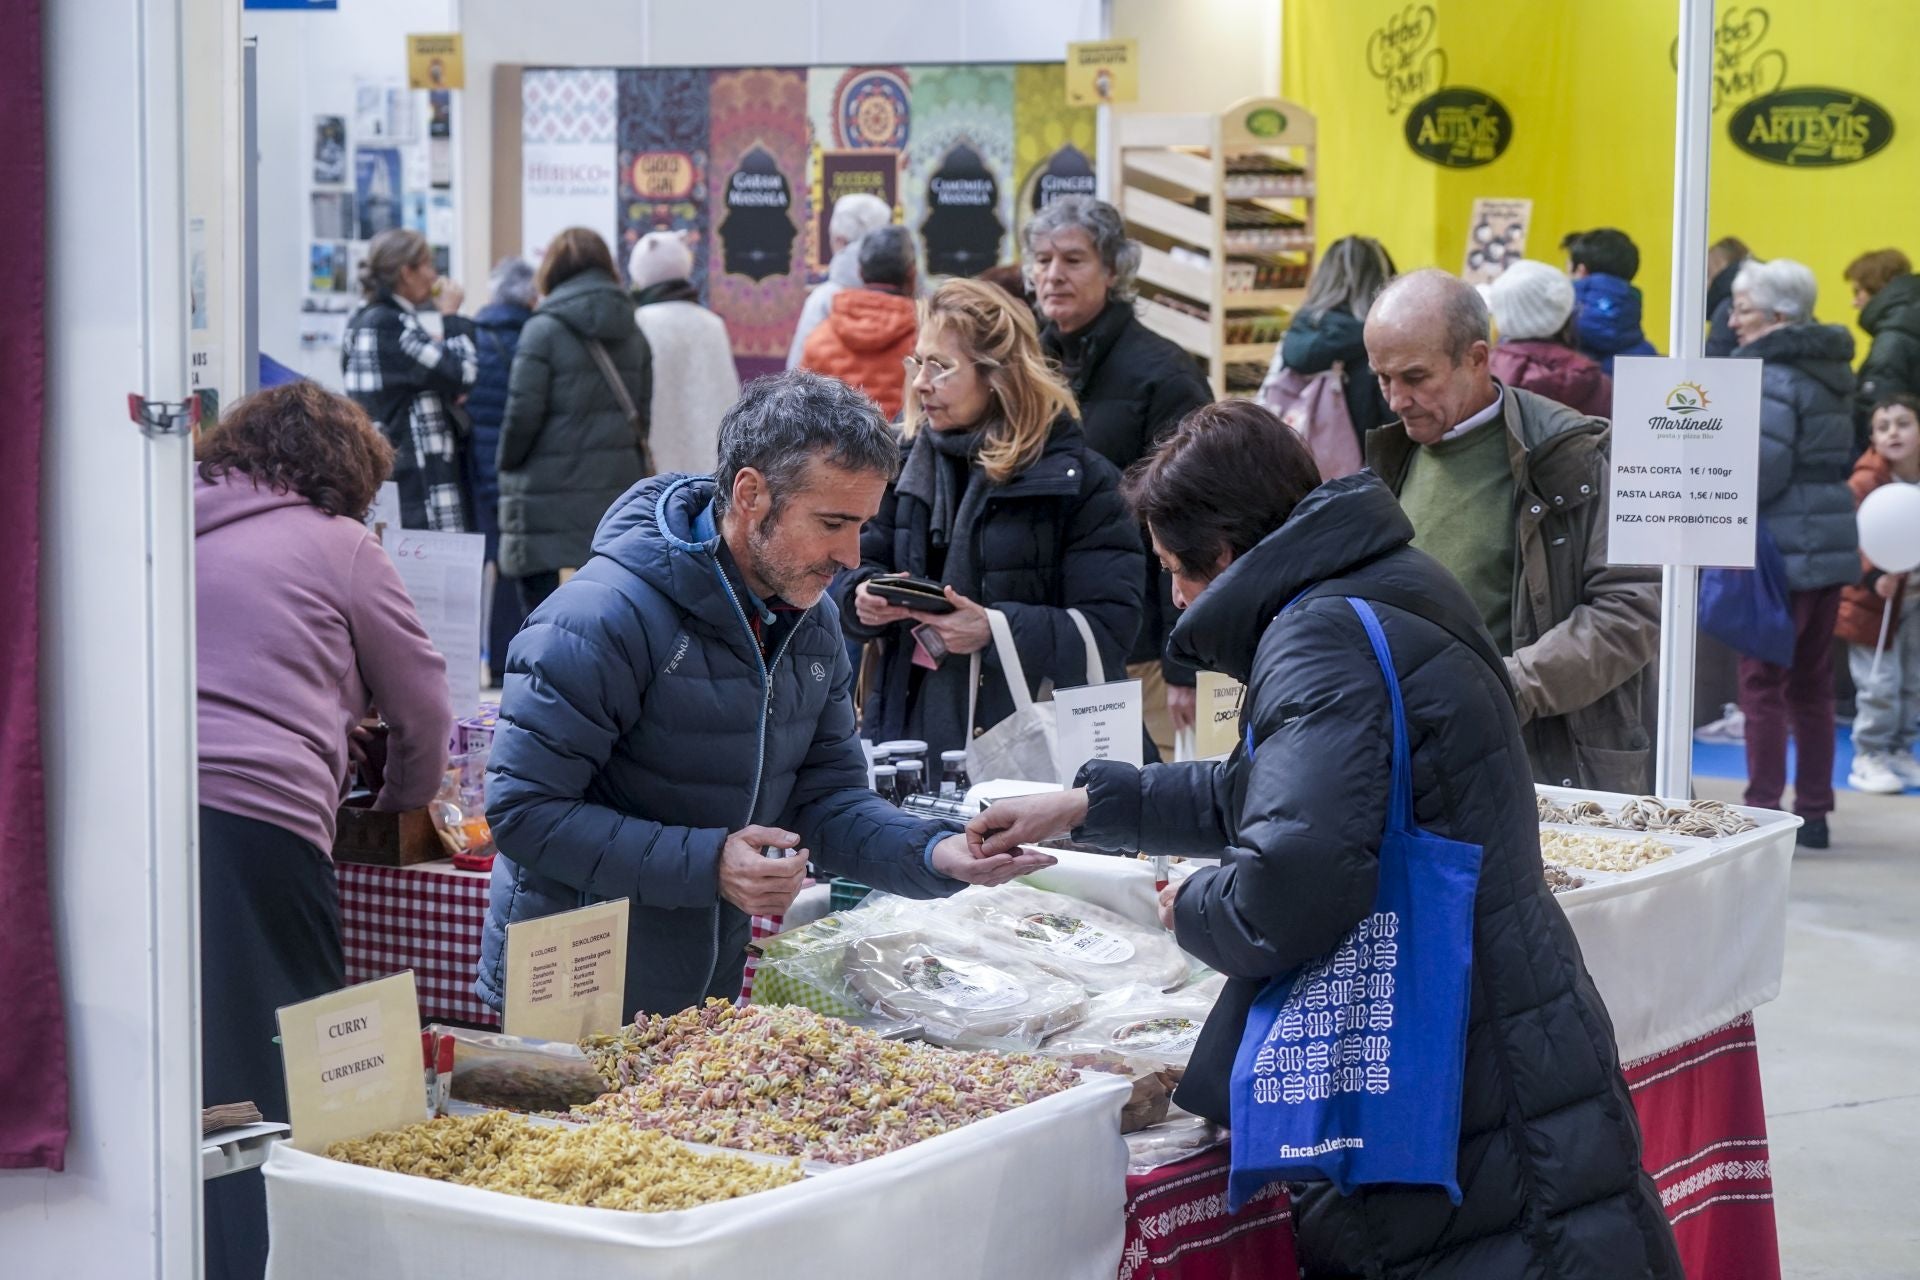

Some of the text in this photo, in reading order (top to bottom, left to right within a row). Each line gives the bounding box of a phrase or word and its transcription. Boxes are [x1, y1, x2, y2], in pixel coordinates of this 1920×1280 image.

[1748, 114, 1871, 144] ARTEMIS
[1648, 416, 1723, 431] Martinelli
[1657, 432, 1676, 440] pasta
[1682, 433, 1701, 441] pizza
[1617, 466, 1647, 474] PASTA
[1650, 466, 1682, 475] CORTA
[1690, 467, 1700, 475] 1€
[1708, 467, 1732, 477] 100gr
[1617, 490, 1647, 499] PASTA
[1649, 491, 1682, 499] LARGA
[1690, 491, 1707, 501] 1,5€
[1715, 492, 1738, 500] NIDO
[1616, 514, 1748, 525] PIZZA CON PROBIÓTICOS 8€
[1072, 701, 1126, 716] TROMPETA CAPRICHO
[535, 946, 557, 956] COLORES
[328, 1016, 368, 1039] CURRY
[321, 1053, 385, 1083] CURRYREKIN
[1279, 1136, 1365, 1159] fincasuletcom
